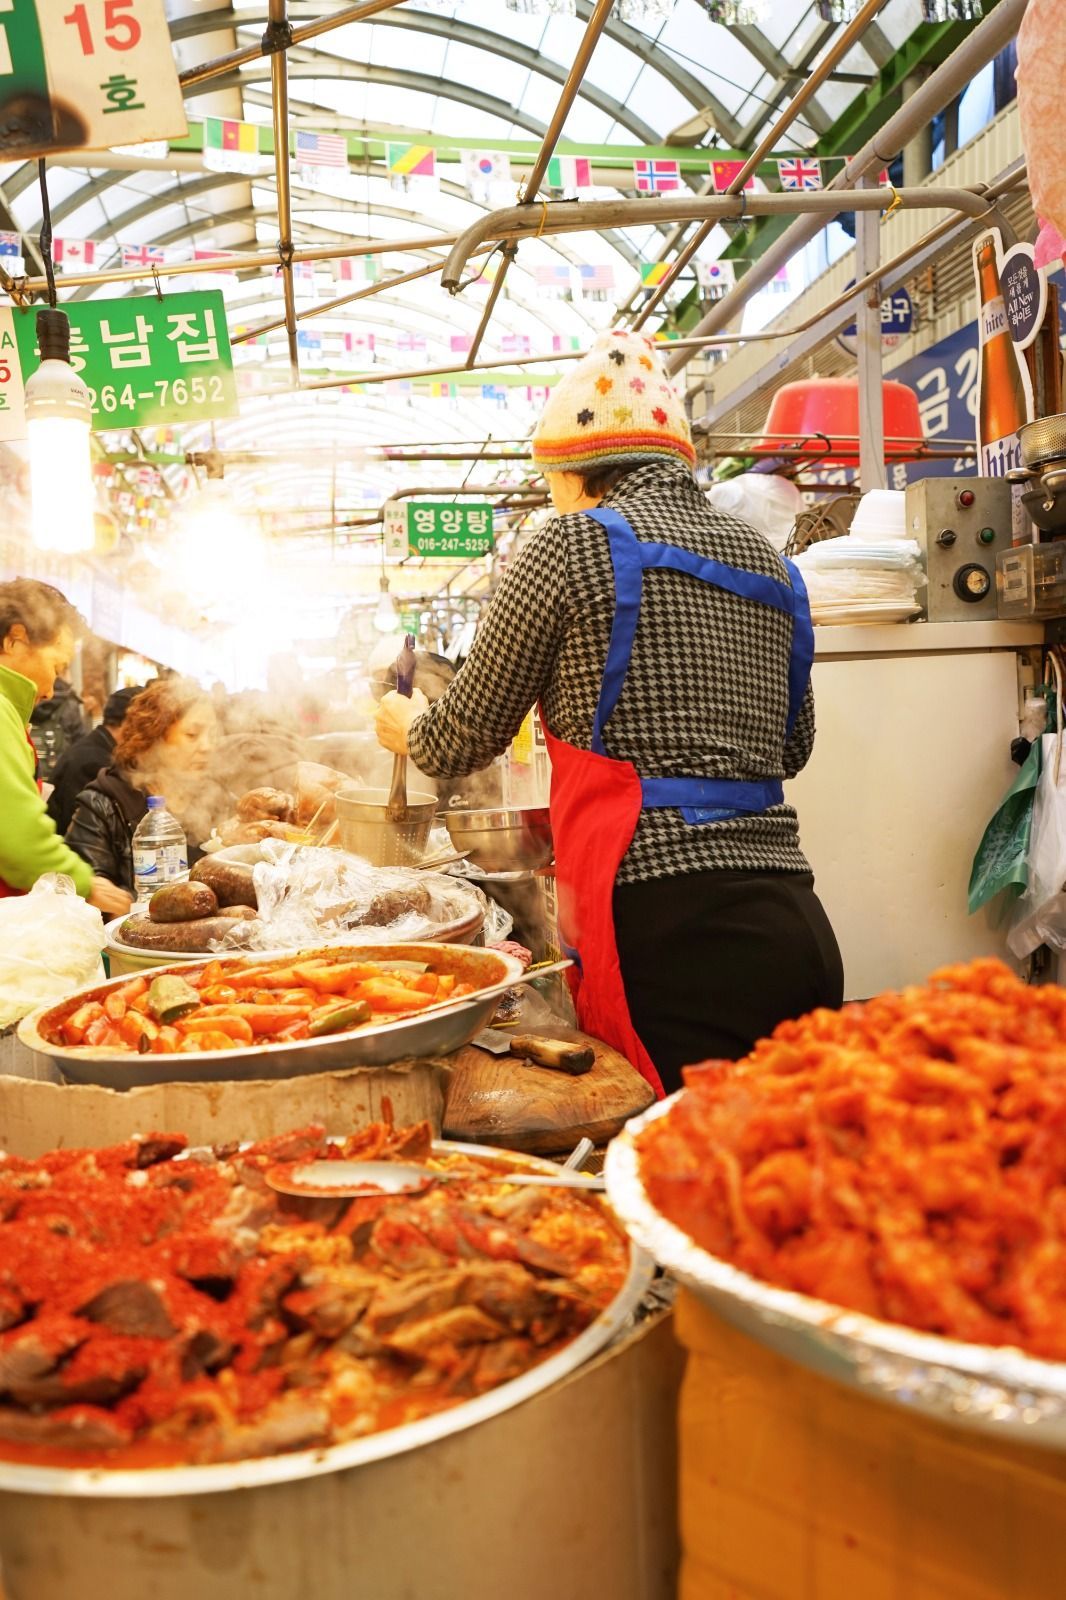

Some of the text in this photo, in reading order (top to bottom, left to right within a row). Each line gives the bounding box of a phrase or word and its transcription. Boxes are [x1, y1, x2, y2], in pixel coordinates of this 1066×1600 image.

[64, 0, 141, 56] 15
[100, 74, 145, 114] 호
[1008, 291, 1034, 316] All New
[1012, 305, 1033, 327] 하이트
[985, 313, 1004, 336] hite
[986, 440, 1022, 478] hite
[389, 524, 404, 534] 14
[413, 508, 489, 534] 영양탕
[417, 538, 490, 552] 016-247-5252
